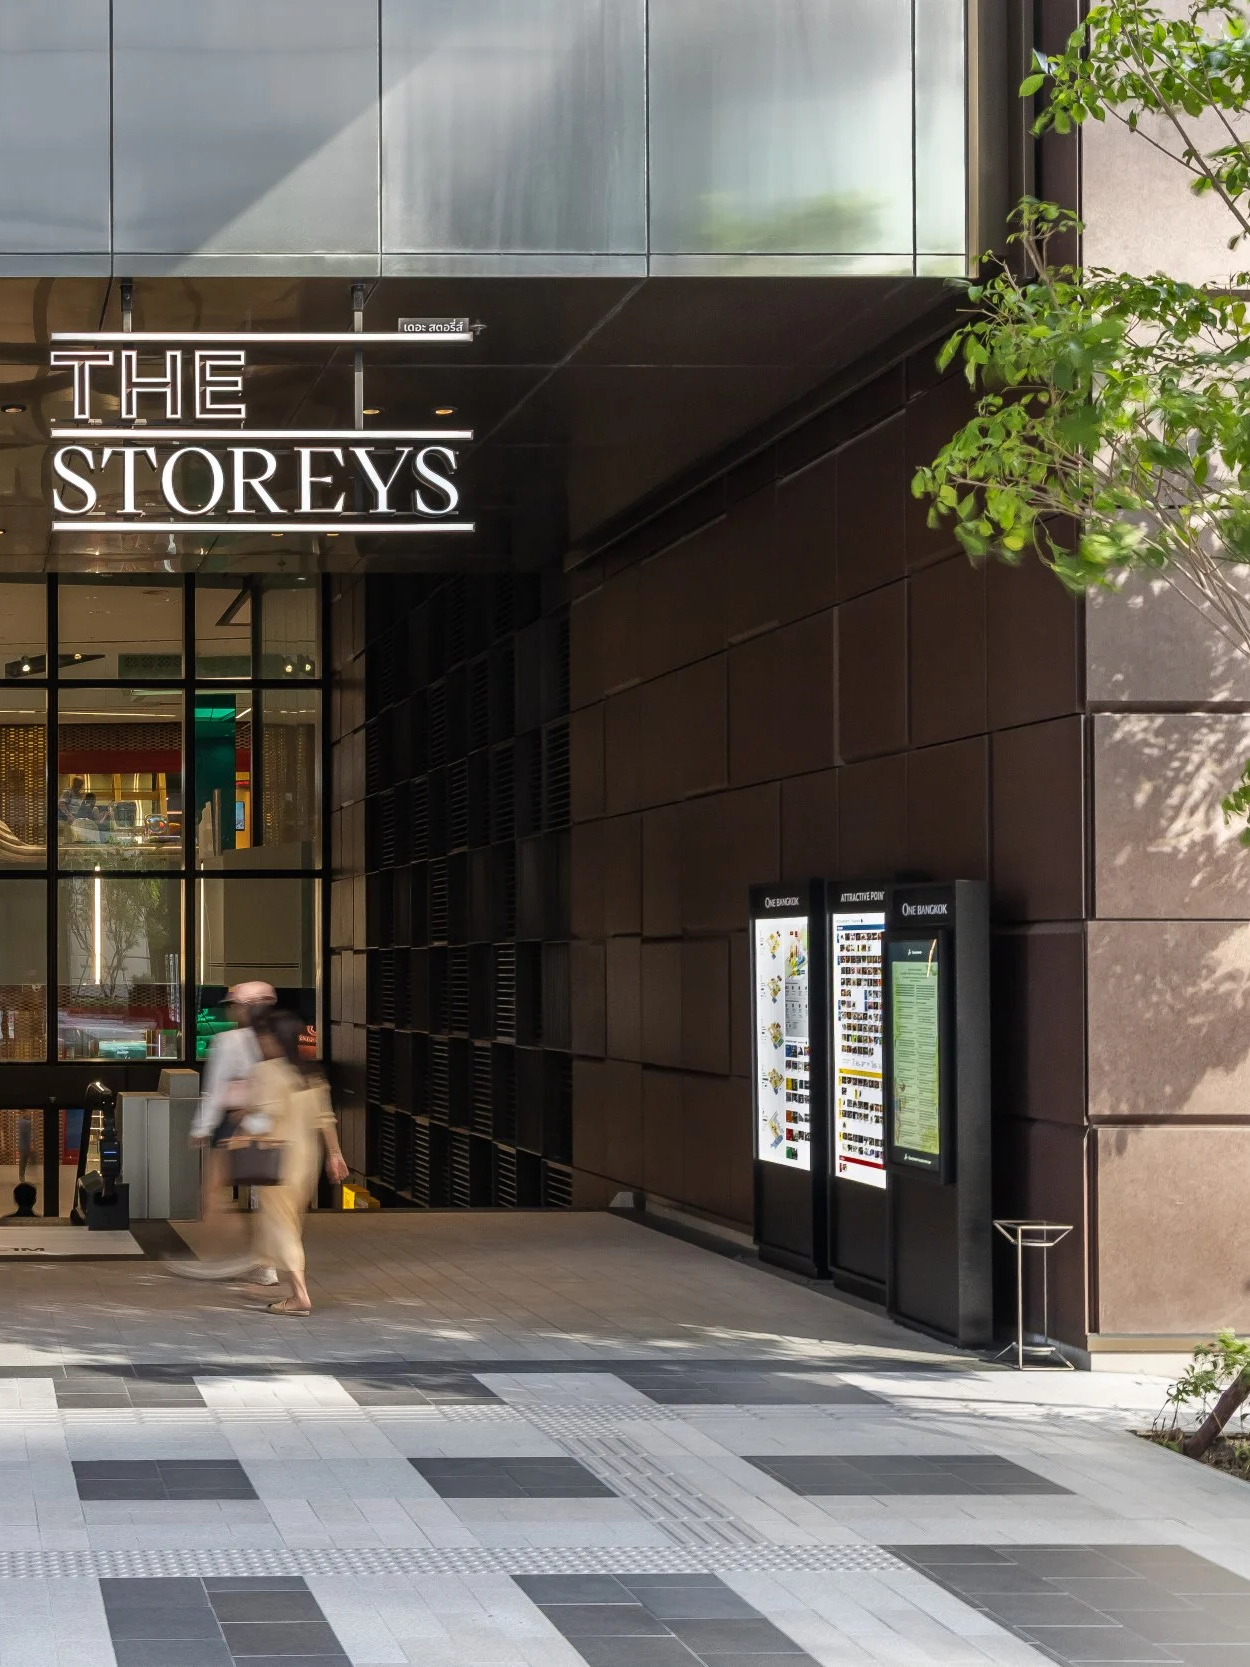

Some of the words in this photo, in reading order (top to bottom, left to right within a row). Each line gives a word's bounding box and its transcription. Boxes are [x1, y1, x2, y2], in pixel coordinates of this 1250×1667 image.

[404, 323, 426, 332] เดอะ
[429, 319, 463, 332] สตอรี่ส์
[50, 350, 246, 419] THE
[52, 445, 459, 516] STOREYS
[840, 892, 870, 903] ATTRACTIVE
[870, 891, 885, 901] POIN
[902, 902, 916, 916] ONE
[917, 903, 948, 915] BANGKOK
